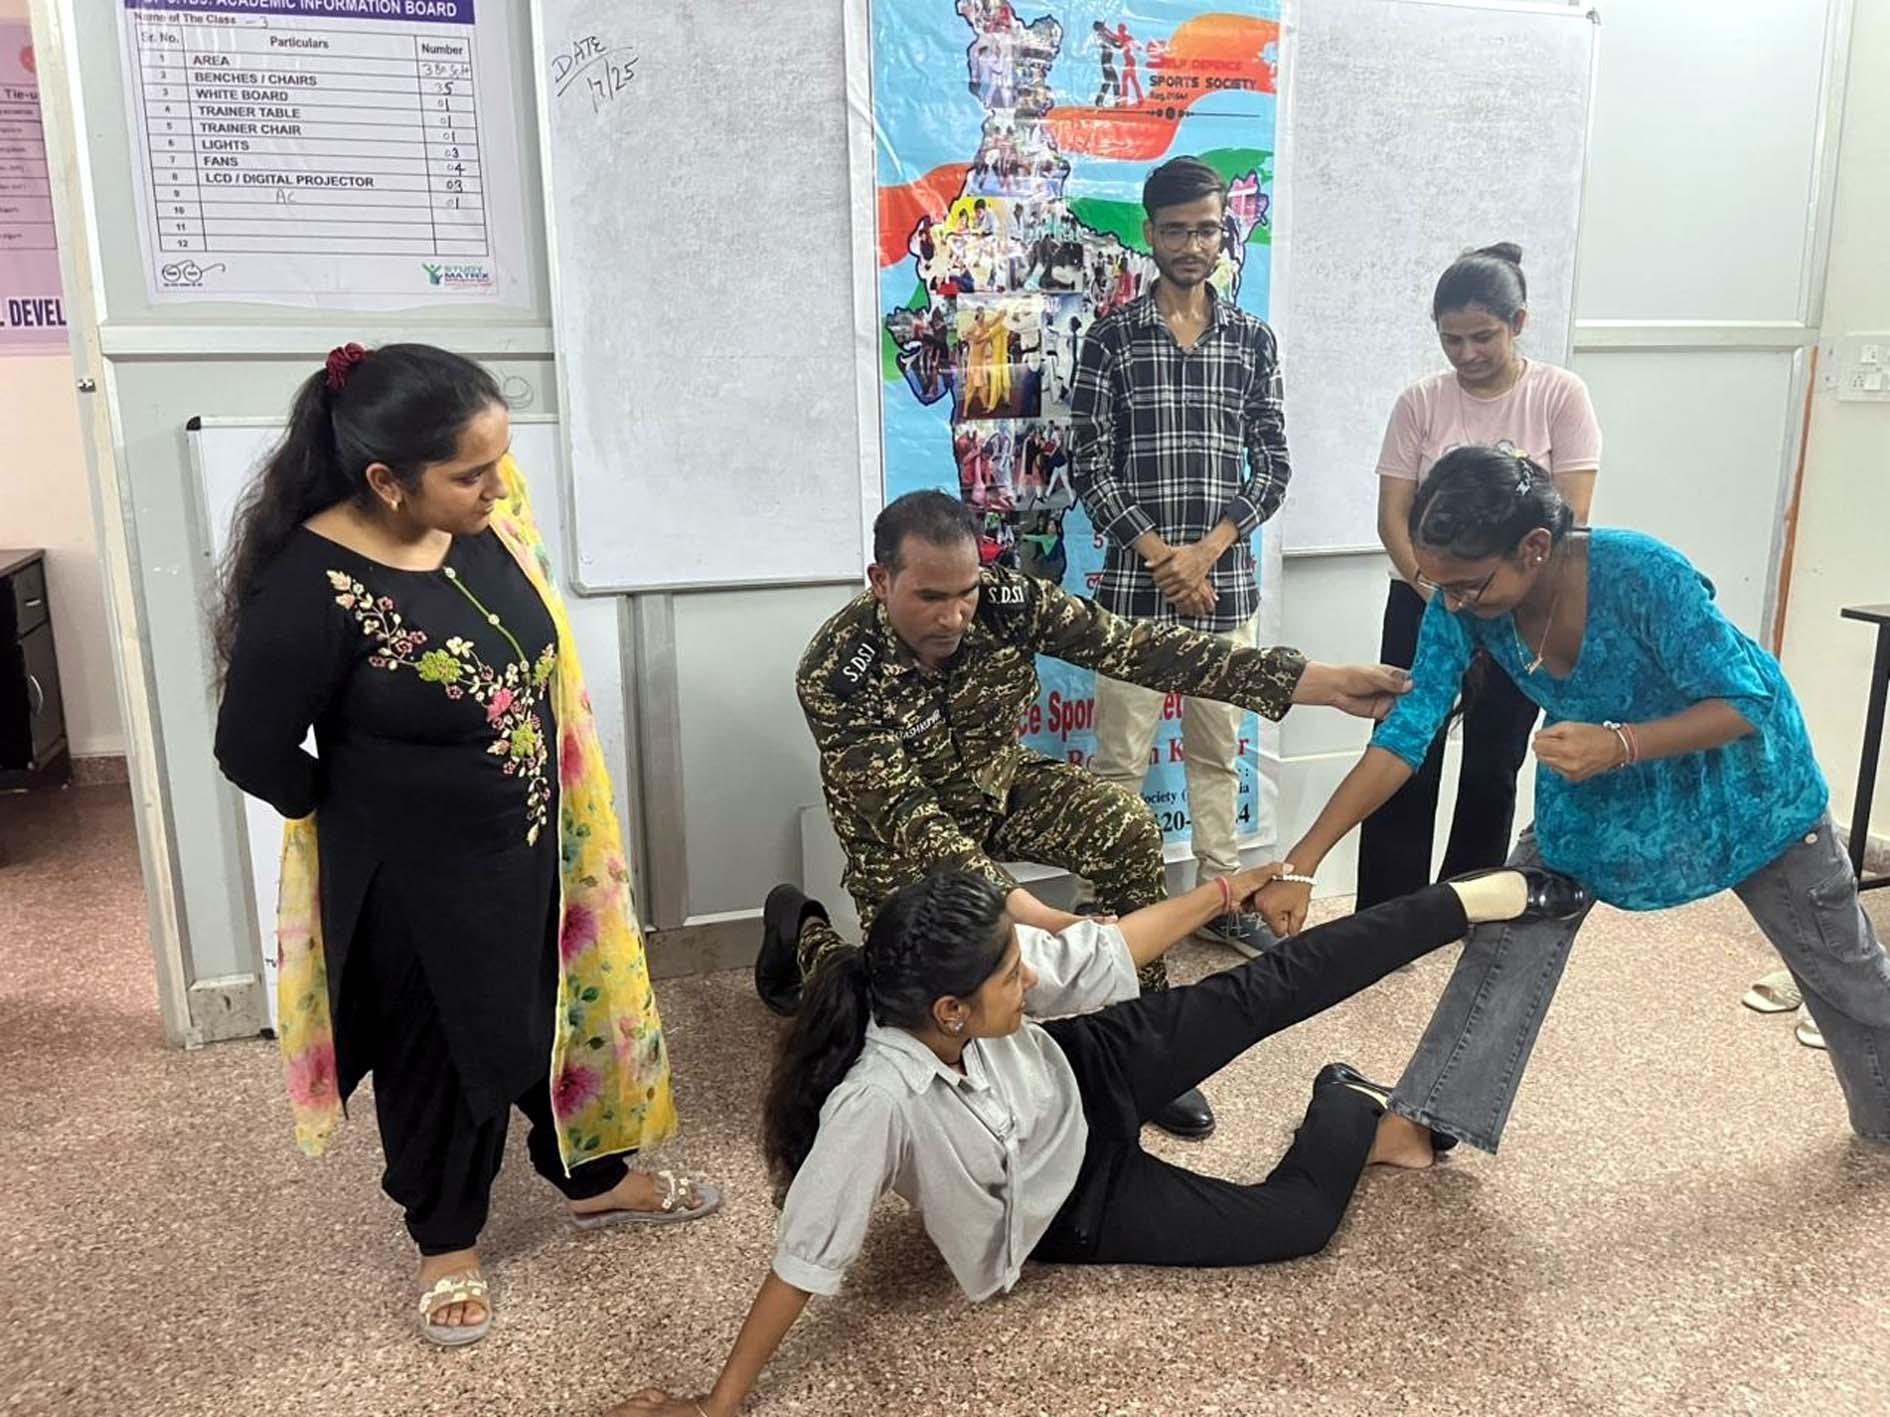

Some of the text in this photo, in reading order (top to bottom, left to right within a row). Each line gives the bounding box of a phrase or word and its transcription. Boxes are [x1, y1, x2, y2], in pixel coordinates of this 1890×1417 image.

[300, 0, 399, 13] INFORMATION
[405, 1, 457, 17] BOARD
[134, 12, 236, 24] Name of The Class
[160, 32, 180, 44] No.
[270, 36, 329, 48] Particulars
[421, 43, 463, 55] Number
[193, 56, 230, 66] AREA
[551, 36, 607, 83] DATE
[195, 72, 258, 83] BENCHES
[268, 74, 317, 86] CHAIRS
[1149, 75, 1257, 90] SPORTS SOCIETY
[196, 89, 288, 101] WHITE BOARD
[165, 105, 170, 113] 4
[198, 105, 301, 118] TRAINER TABLE
[167, 122, 172, 130] 5
[200, 123, 302, 135] TRAINER CHAIR
[202, 139, 250, 151] LIGHTS
[204, 156, 239, 167] FANS
[206, 173, 232, 183] LCD
[243, 174, 294, 185] DIGITAL
[296, 175, 374, 187] PROJECTOR
[174, 206, 185, 214] 10
[176, 223, 186, 231] 11
[178, 240, 188, 248] 12
[9, 299, 67, 327] DEVEL
[1140, 790, 1177, 806] ociety
[1154, 810, 1192, 832] 20-
